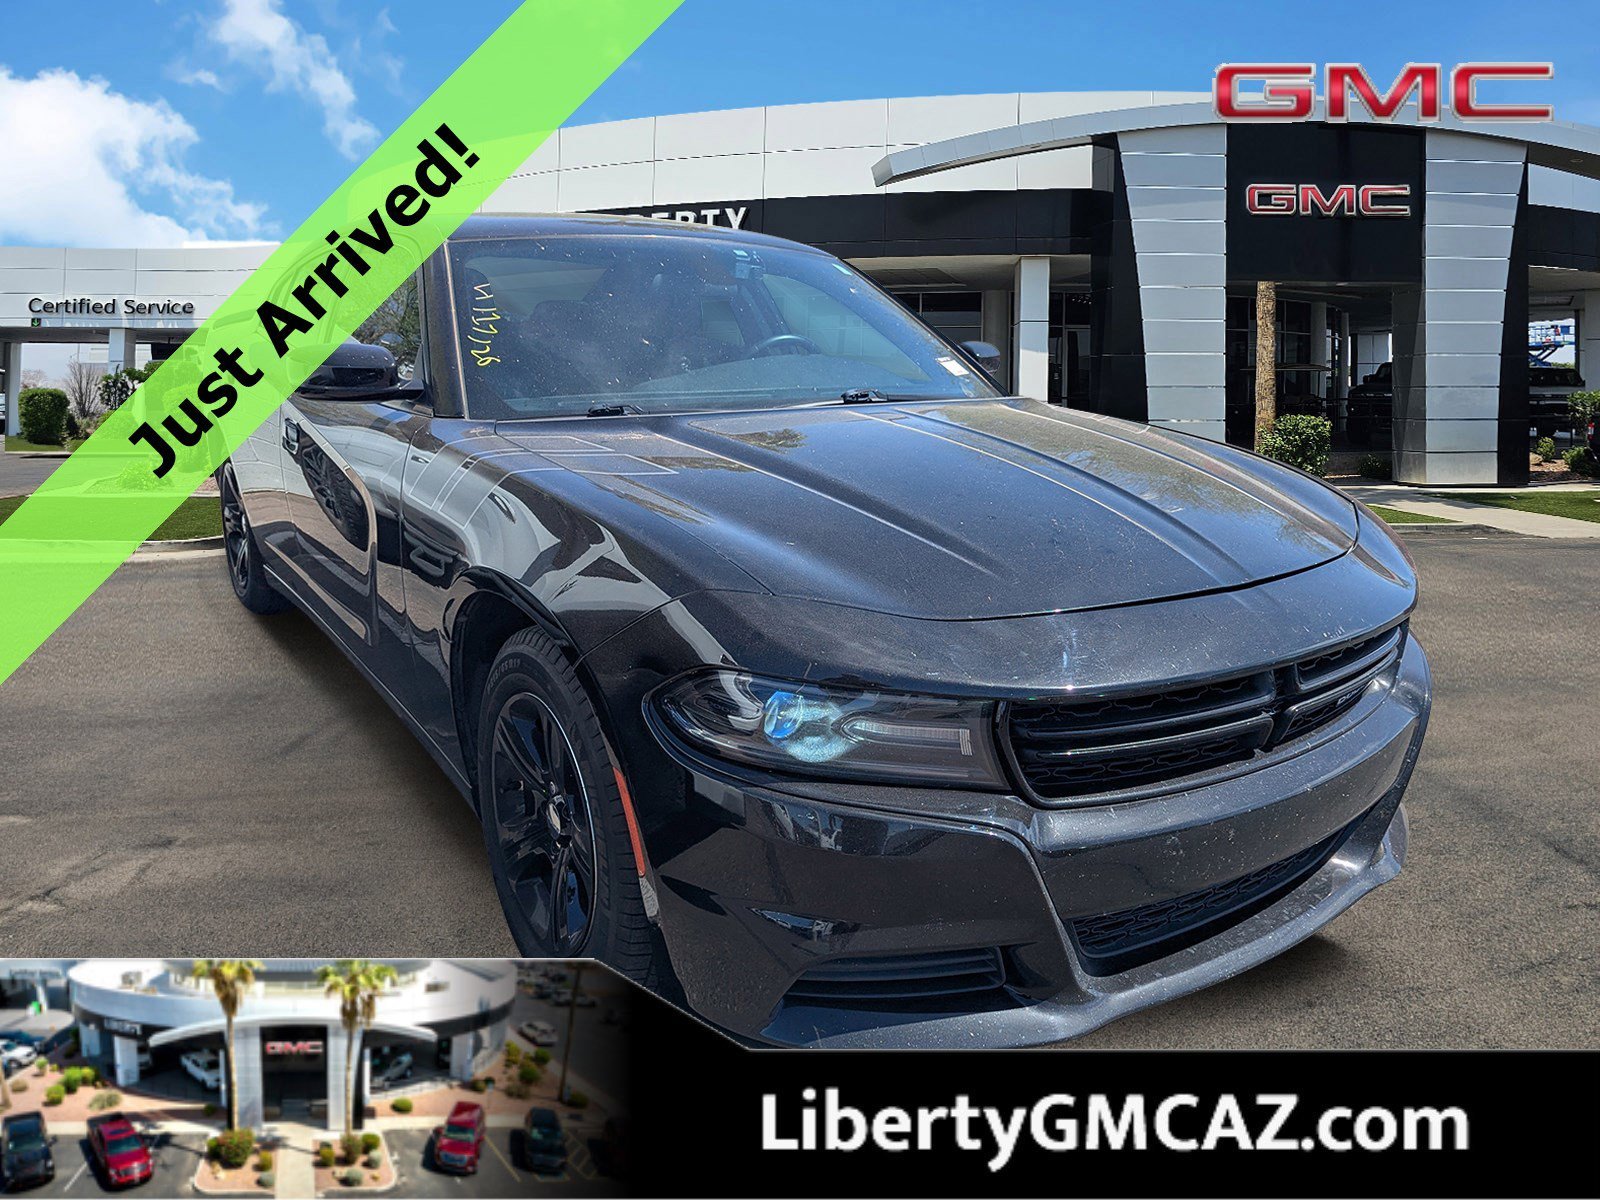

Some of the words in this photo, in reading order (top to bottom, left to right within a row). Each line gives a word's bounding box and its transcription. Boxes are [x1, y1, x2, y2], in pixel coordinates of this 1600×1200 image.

[1245, 183, 1411, 217] GMC
[28, 297, 117, 315] Certified
[124, 299, 194, 315] Service
[265, 1041, 323, 1055] GMC
